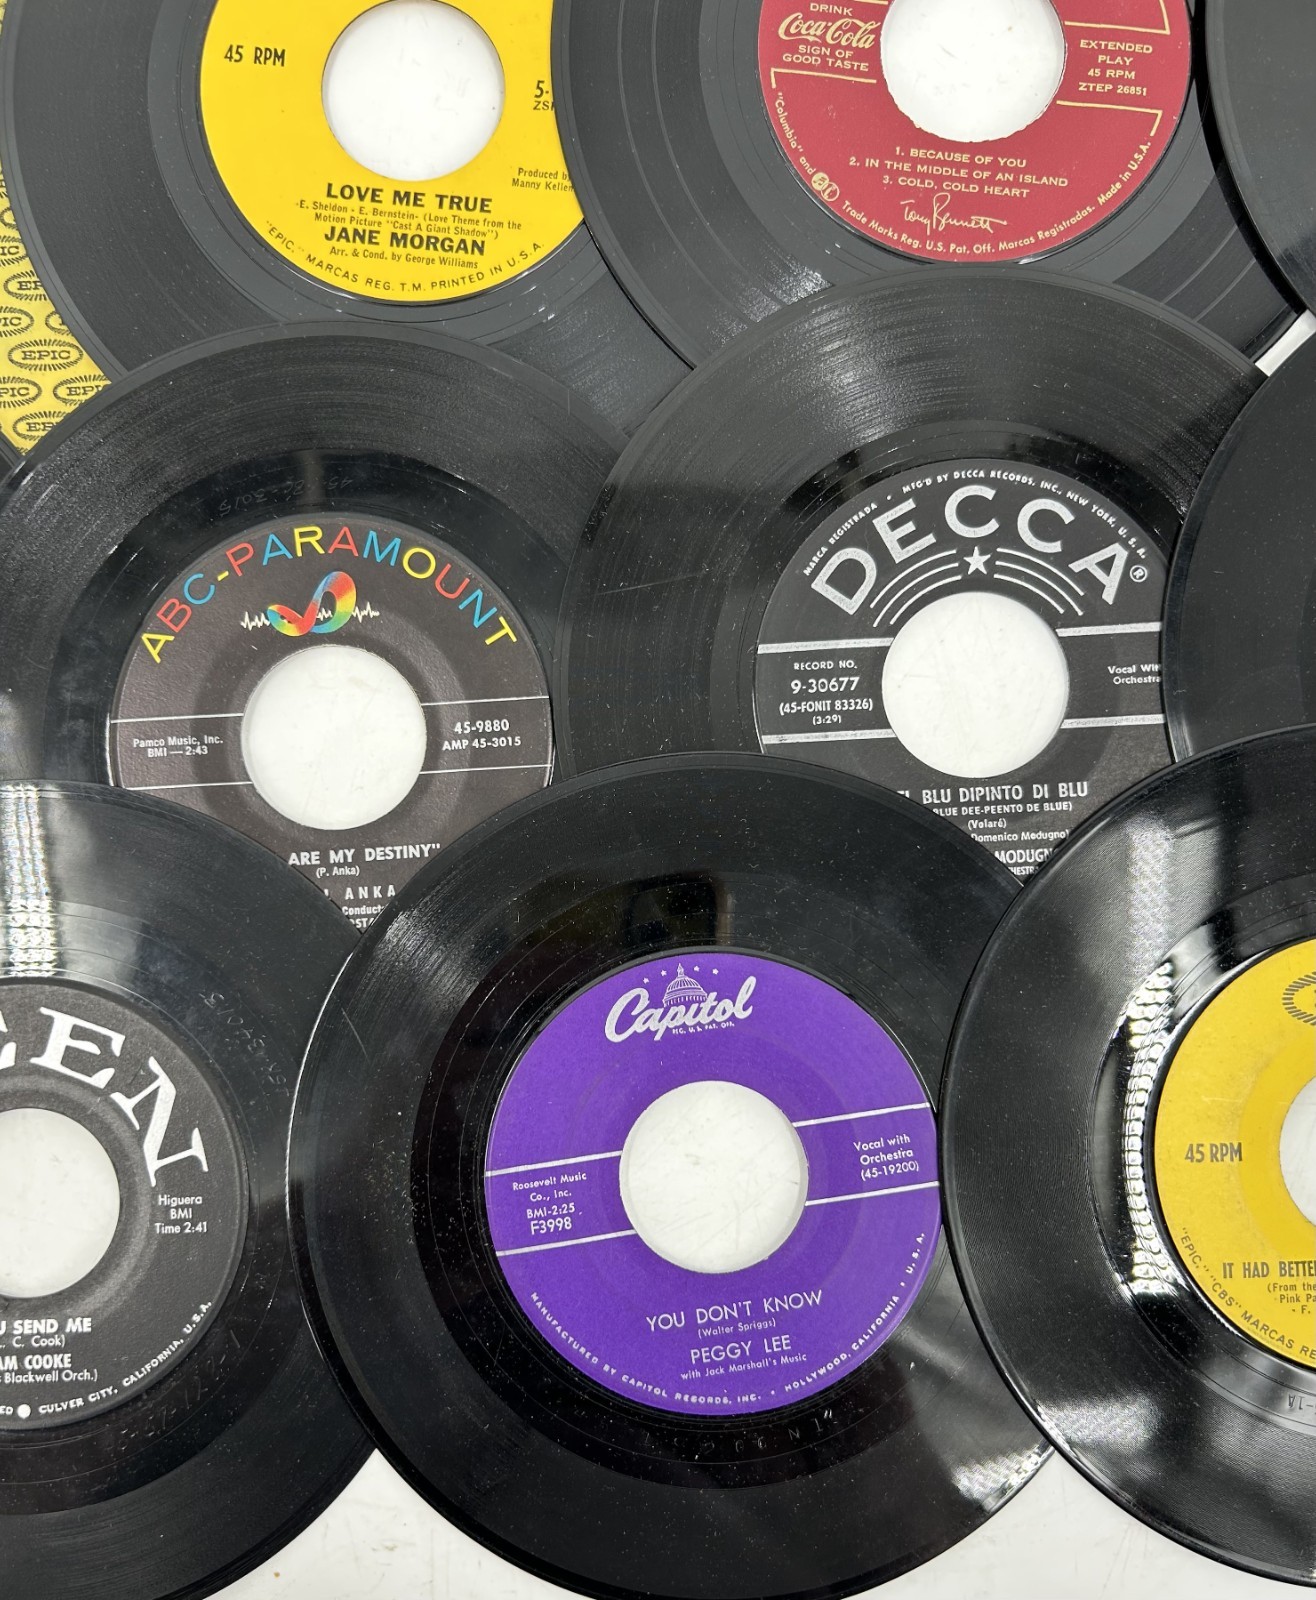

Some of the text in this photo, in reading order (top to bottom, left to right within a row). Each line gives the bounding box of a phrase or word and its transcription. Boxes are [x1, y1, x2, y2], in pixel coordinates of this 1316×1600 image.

[810, 2, 853, 17] DRINK
[798, 44, 854, 59] SIGN OF
[1079, 39, 1153, 54] EXTENDED
[224, 44, 286, 67] 45 RPM
[782, 53, 869, 72] GOOD TASTE
[1097, 55, 1133, 66] PLAY
[1087, 68, 1136, 80] 45 RPM
[1078, 82, 1147, 96] ZTEP 26851
[799, 156, 816, 176] and
[909, 148, 1026, 168] BECAUSE OF YOU
[518, 167, 559, 180] Produced
[865, 158, 1068, 187] IN THE MIDDLE OF AN ISLAND
[512, 178, 541, 190] Manny
[942, 182, 979, 193] COLD
[984, 185, 1030, 198] HEART
[326, 183, 493, 214] LOVE ME TRUE
[842, 141, 1151, 255] Trade Marks Reg. U.S. Pat. Off. Marcas Registradas. Made U.S.A.
[312, 201, 522, 231] Sheldon (Love Theme from the
[314, 212, 451, 235] Motion Picture Giant
[324, 226, 486, 256] JANE MORGAN
[329, 246, 479, 269] Arr. Cond. George Williams
[305, 241, 545, 292] MARCAS REG. T.M. PRINTED IN U.S.A.
[21, 349, 71, 361] EPIC
[803, 469, 1116, 577] MARCA REGISTRADA MFG'D BY DECCA RECORDS, NEW YORK,
[811, 484, 1129, 616] DECCA
[141, 525, 518, 663] ABC-PARAMOUNT
[793, 659, 858, 671] RECORD NO.
[1107, 664, 1136, 674] Vocal
[790, 676, 860, 694] 9-30677
[1113, 675, 1161, 685] Orchestra
[779, 698, 873, 716] (45-FONIT 83326)
[454, 718, 510, 734] 45-9880
[812, 714, 842, 725] (3:29)
[133, 734, 224, 748] Pamco Music, Inc.
[442, 736, 521, 751] AMP 45-3015
[147, 745, 208, 758] BMI 2:43
[922, 788, 951, 805] BLU
[959, 785, 1023, 803] DIPINTO
[1032, 783, 1049, 799] DI
[1058, 781, 1088, 798] BLU
[961, 801, 1073, 815] DEE-PEENTO DE BLUE)
[288, 851, 321, 866] ARE
[329, 849, 356, 864] MY
[332, 865, 360, 876] Anka)
[345, 884, 396, 900] ANKA
[604, 975, 757, 1043] Capitol
[853, 1133, 911, 1151] Vocal with
[860, 1148, 914, 1165] Orchestra
[1184, 1142, 1243, 1163] 45 RPM
[860, 1160, 919, 1181] (45-19200)
[512, 1172, 587, 1191] Roosevelt Music
[158, 1194, 203, 1207] Higuera
[554, 1190, 572, 1198] Inc.
[170, 1207, 193, 1220] BMI
[526, 1202, 576, 1219] BMI-2:25
[154, 1221, 207, 1234] Time 2:41
[530, 1216, 573, 1235] F3998
[1222, 1262, 1270, 1279] IT HAD
[1267, 1282, 1297, 1293] (From
[1279, 1293, 1301, 1303] Pink
[646, 1289, 822, 1332] YOU DON'T KNOW
[13, 1318, 59, 1335] SEND
[65, 1317, 92, 1333] ME
[697, 1317, 776, 1340] (Walter Spriggs)
[1240, 1310, 1295, 1349] MARCAS
[31, 1334, 66, 1348] Cook)
[531, 1292, 599, 1364] MANUFACTURED
[602, 1363, 617, 1376] BY
[621, 1374, 668, 1397] CAPITOL
[737, 1394, 762, 1403] INC.
[784, 1352, 851, 1392] HOLLYWOOD,
[851, 1295, 900, 1351] CALIFORNIA
[690, 1334, 792, 1365] PEGGY LEE
[23, 1353, 72, 1370] COOKE
[38, 1301, 212, 1415] CULVER CITY, CALIFORNIA, U.S.A.
[680, 1352, 807, 1381] with Jack Marshall's Music
[4, 1369, 98, 1384] Blackwell Orch.)
